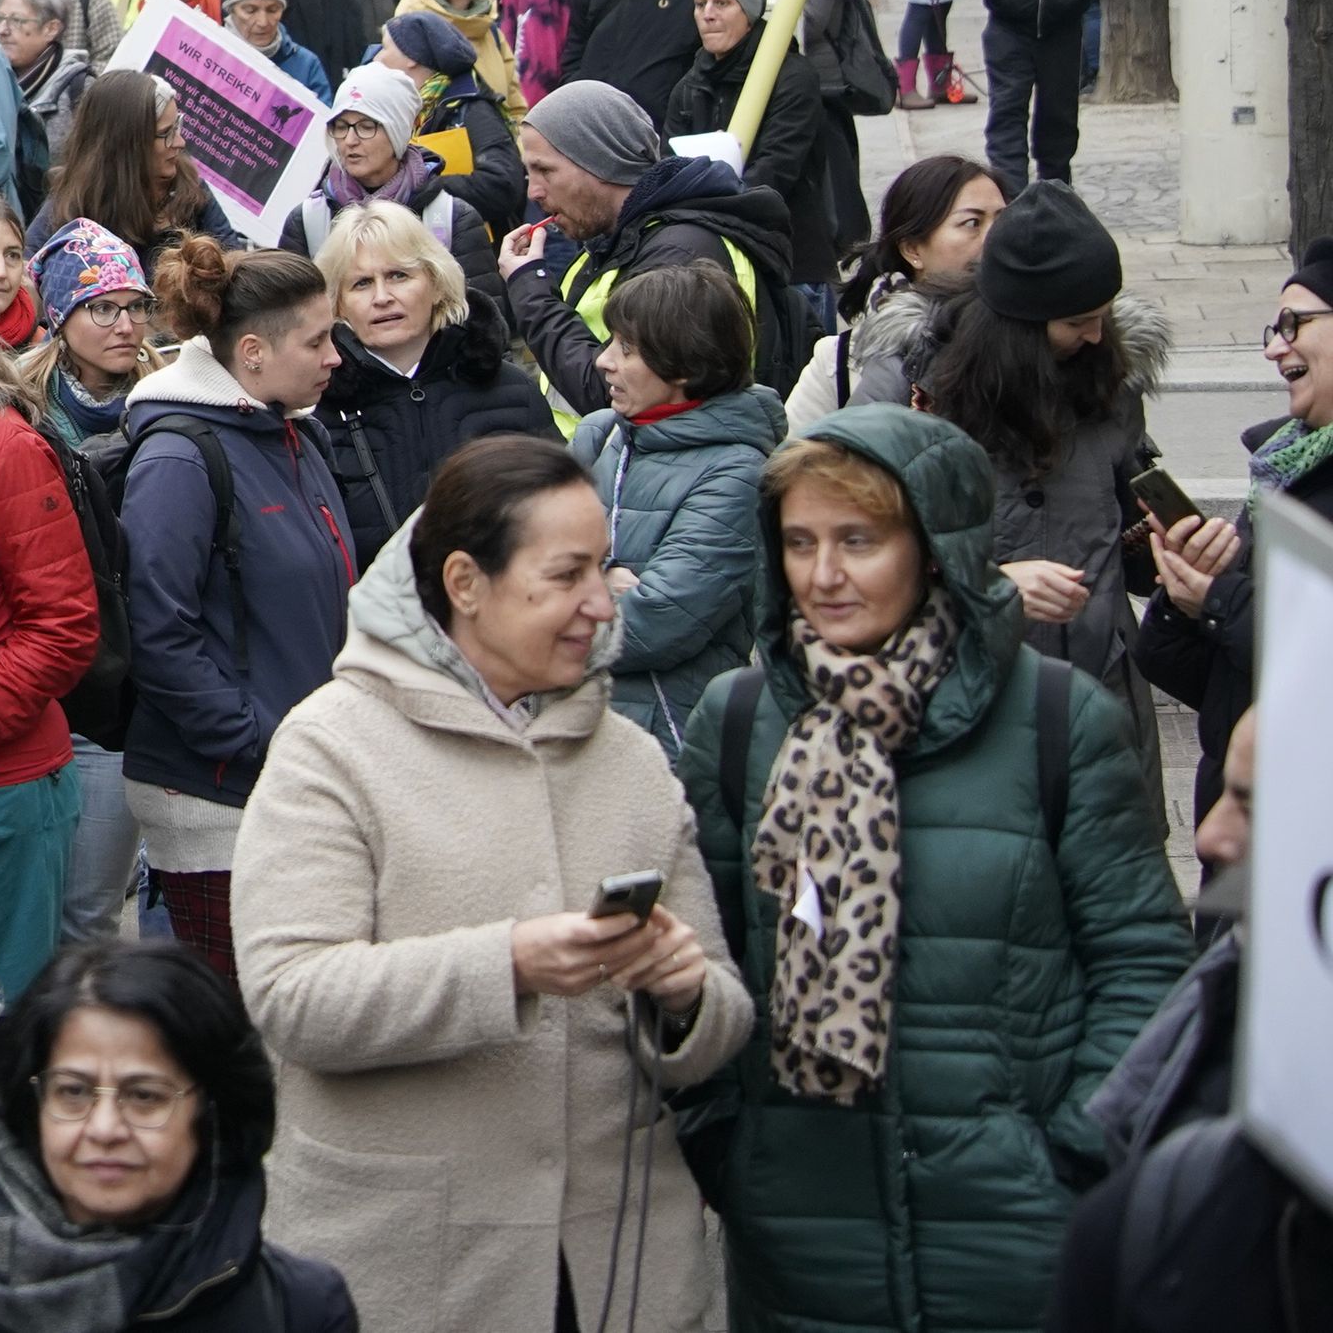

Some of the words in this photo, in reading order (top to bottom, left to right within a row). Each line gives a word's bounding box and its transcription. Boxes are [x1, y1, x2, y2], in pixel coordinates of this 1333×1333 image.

[178, 40, 202, 63] WIR
[203, 57, 261, 103] STREIKEN
[164, 67, 184, 87] Weil
[185, 83, 200, 97] wir
[199, 94, 228, 118] genug
[228, 111, 256, 138] haben
[257, 132, 274, 150] von
[180, 126, 235, 168] mpromissen!
[212, 133, 229, 150] und
[230, 144, 257, 169] faulen
[223, 126, 279, 169] gebrochenen
